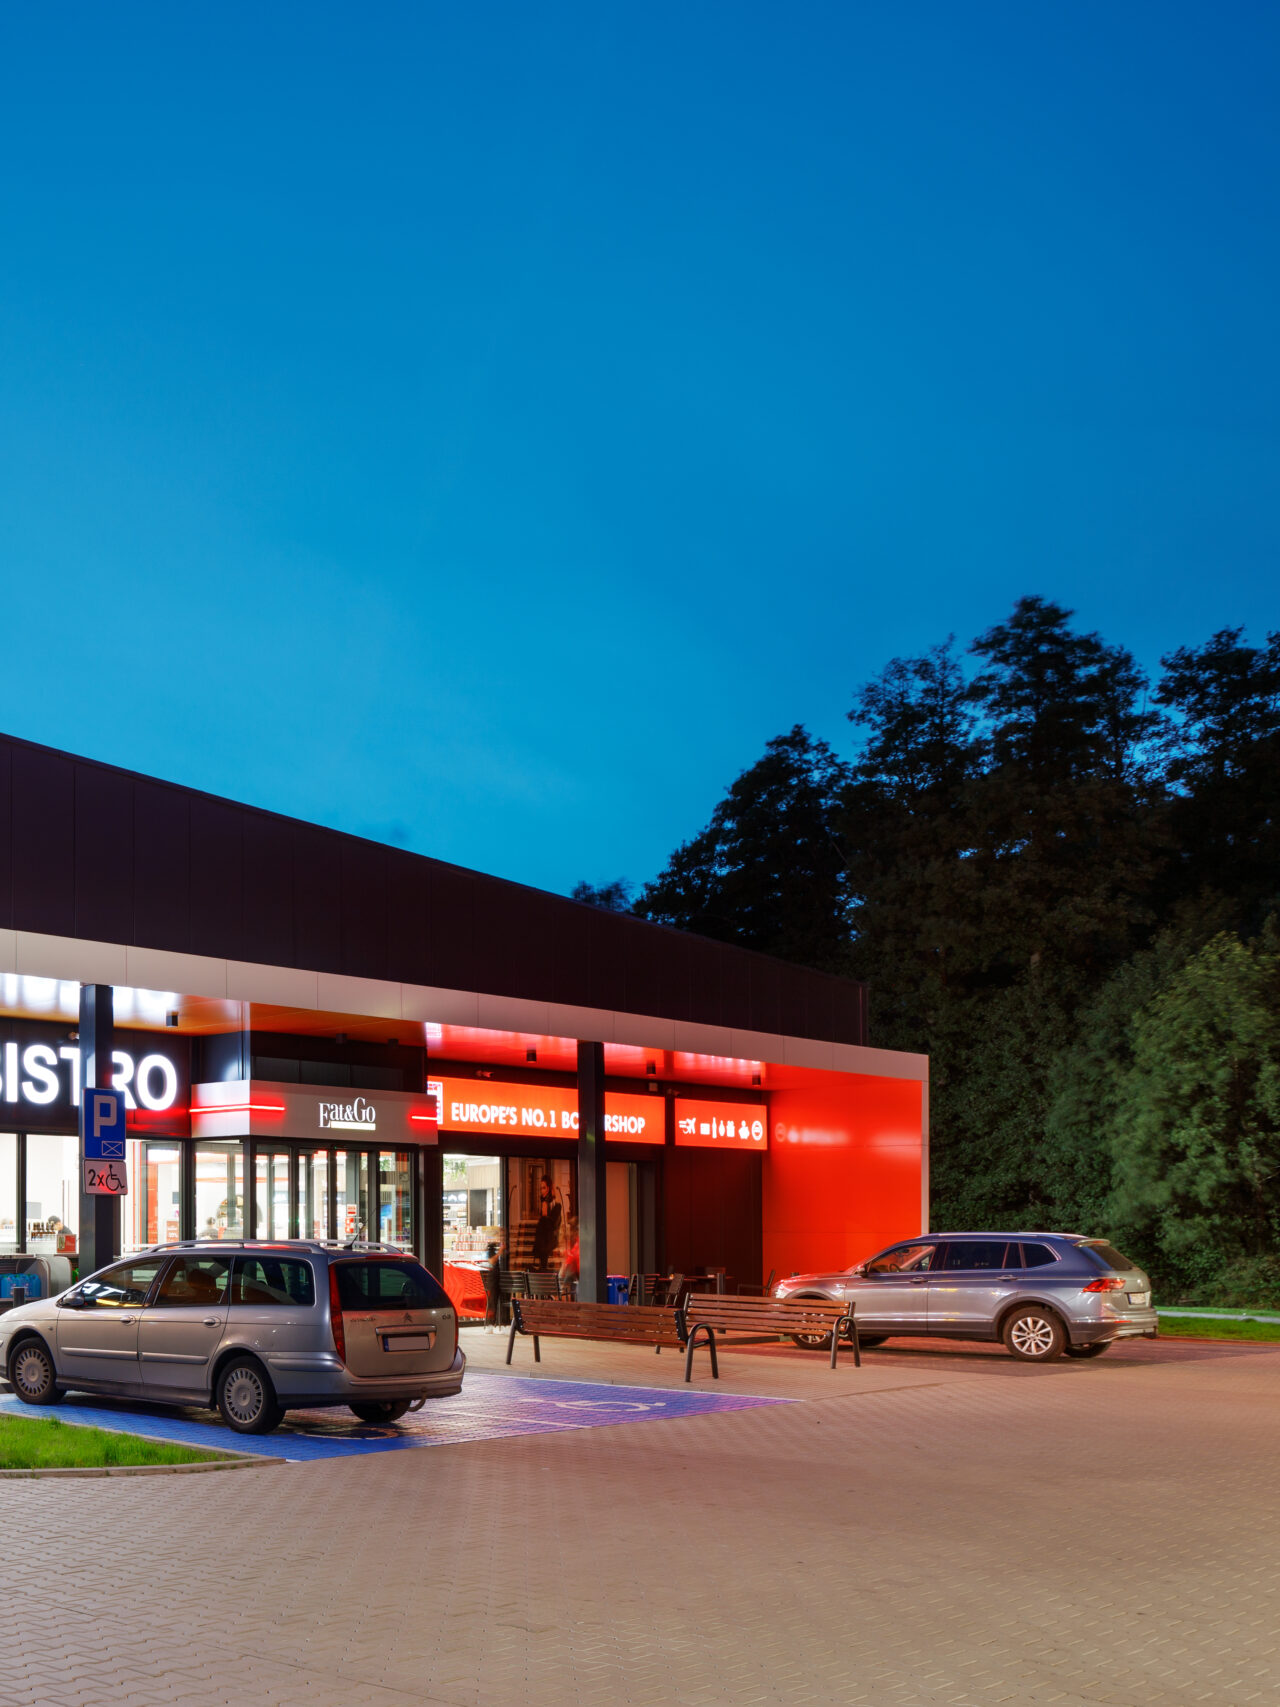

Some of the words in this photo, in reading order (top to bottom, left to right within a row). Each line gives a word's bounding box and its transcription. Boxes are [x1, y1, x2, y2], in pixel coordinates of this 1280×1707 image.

[93, 1095, 117, 1137] P
[318, 1097, 377, 1128] Eat&Go
[451, 1102, 518, 1125] EUROPE'S
[561, 1111, 646, 1134] BORSHOP
[87, 1168, 105, 1186] 2x
